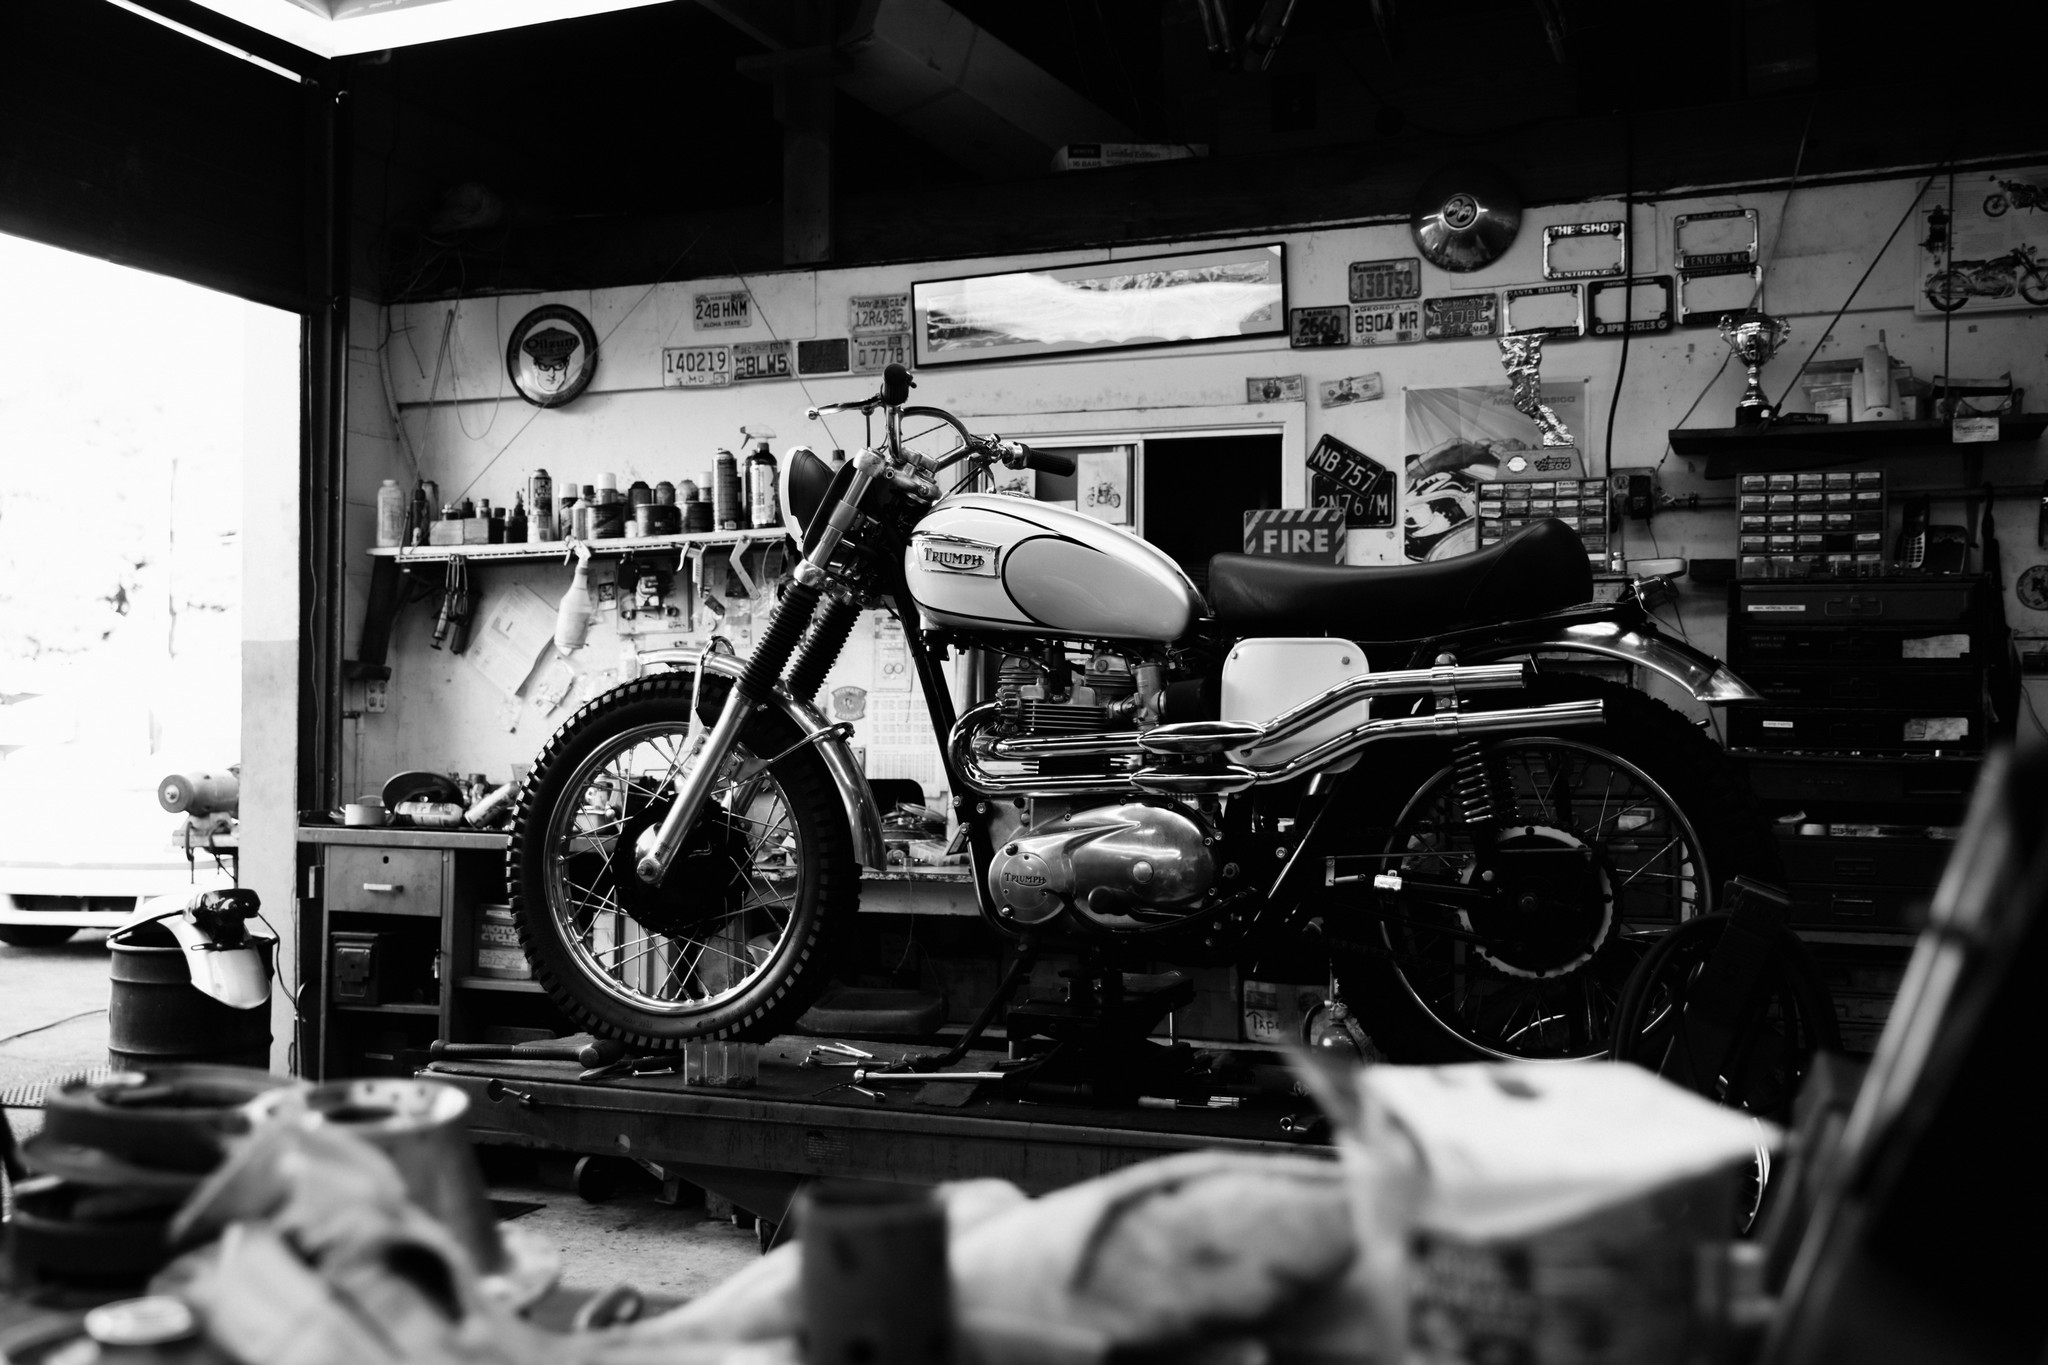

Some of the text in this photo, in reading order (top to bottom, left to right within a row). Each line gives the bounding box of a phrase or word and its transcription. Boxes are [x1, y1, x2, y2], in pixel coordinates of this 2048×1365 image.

[1550, 222, 1620, 236] THE SHOP
[1684, 251, 1749, 266] CENTURY M/C
[696, 300, 748, 320] 248 HNM
[856, 308, 904, 327] 12R4985
[1360, 304, 1401, 312] GEORGIA
[1299, 315, 1341, 337] 2660
[1399, 310, 1418, 330] MR
[858, 339, 886, 347] ILLINOIS
[667, 351, 727, 373] 140219
[746, 353, 788, 376] BLW5
[871, 347, 904, 365] 7778
[1263, 528, 1330, 554] FIRE
[924, 547, 985, 570] TRIUMPH
[1004, 872, 1047, 887] TRIUMPH
